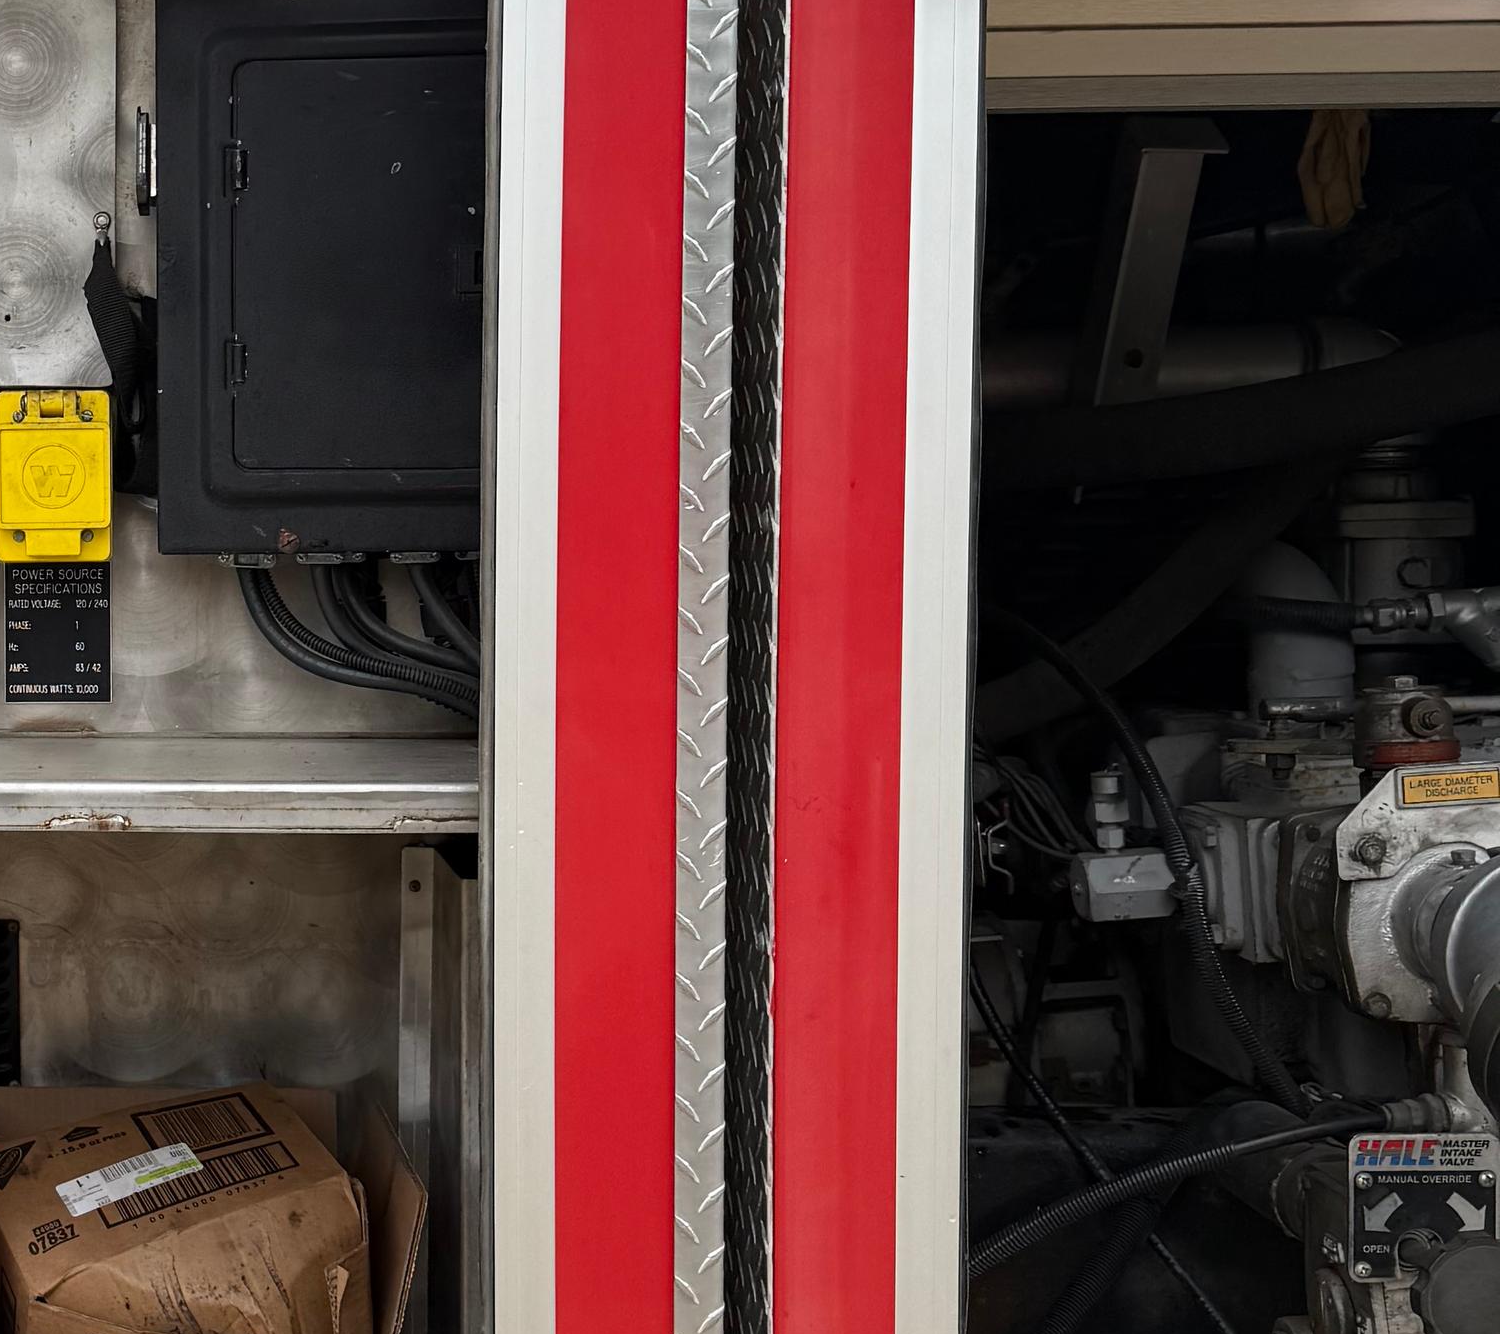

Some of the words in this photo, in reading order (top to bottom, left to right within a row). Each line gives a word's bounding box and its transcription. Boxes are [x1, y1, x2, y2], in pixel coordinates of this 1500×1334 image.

[12, 569, 54, 580] POWER
[58, 568, 104, 580] SOURCE
[14, 582, 102, 595] SPECIFICATIONS
[8, 599, 30, 609] RATED
[75, 599, 87, 609] 120
[94, 599, 109, 609] 240
[75, 641, 85, 651] 60
[92, 663, 102, 673] 42
[8, 684, 48, 694] CONTINUOUS
[75, 684, 99, 695] 10,000
[1409, 778, 1442, 789] LARGE
[1445, 775, 1494, 787] DIAMETER
[1425, 786, 1479, 798] DISCHARGE
[1355, 1139, 1442, 1166] HALE
[1442, 1139, 1490, 1149] MASTER
[1440, 1148, 1483, 1157] INTAKE
[1439, 1157, 1475, 1166] VALVE
[1377, 1175, 1420, 1184] MANUAL
[1421, 1174, 1472, 1184] OVERRIDE
[150, 1213, 165, 1223] 00
[175, 1196, 216, 1213] 44000
[226, 1178, 267, 1196] 07837
[28, 1223, 77, 1255] 07837
[1362, 1244, 1391, 1254] OPEN
